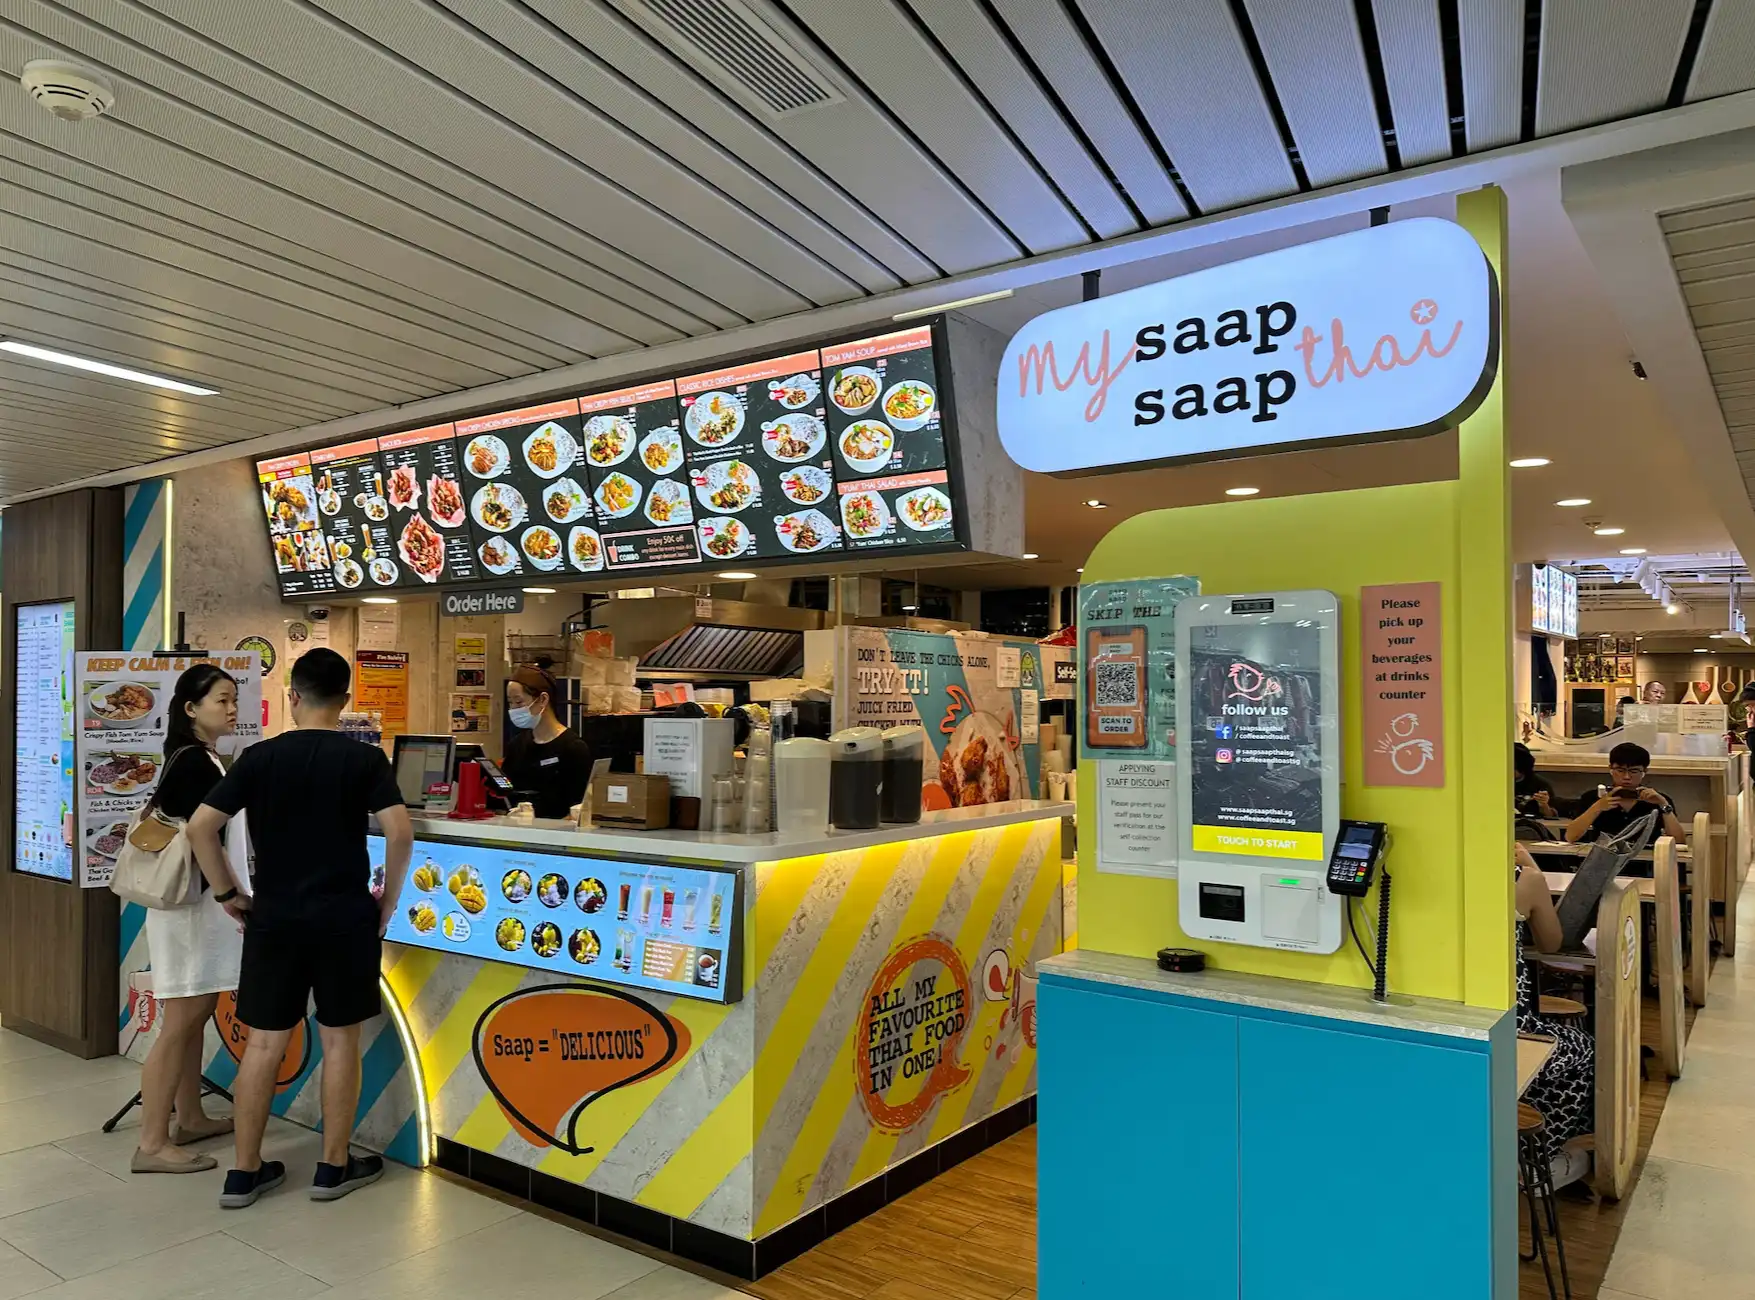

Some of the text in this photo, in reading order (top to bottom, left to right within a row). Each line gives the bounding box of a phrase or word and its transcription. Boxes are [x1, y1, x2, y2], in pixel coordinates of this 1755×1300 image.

[824, 354, 841, 363] TOM
[856, 346, 876, 357] SOUP
[1018, 298, 1464, 423] my saap thai
[1133, 369, 1297, 428] saap
[877, 478, 897, 488] SALAD
[646, 537, 663, 546] Enjoy
[675, 534, 684, 543] off
[619, 553, 640, 562] COMBO
[446, 592, 516, 613] Order Here
[1381, 599, 1421, 609] Please
[1087, 605, 1161, 620] SKIP THE
[1379, 617, 1423, 629] pick up
[1387, 636, 1415, 647] your
[86, 657, 126, 672] KEEP
[128, 657, 170, 672] CALM
[173, 656, 185, 671] &
[224, 655, 252, 670] ON!
[857, 648, 886, 662] DON'T
[890, 650, 916, 663] LEAVE
[919, 652, 934, 665] THE
[938, 653, 964, 667] CHICKS
[1372, 653, 1432, 664] beverages
[857, 667, 929, 695] TRY IT!
[1375, 671, 1430, 681] at drinks
[1379, 690, 1426, 700] counter
[857, 701, 914, 714] JUICY FRIED
[1221, 703, 1289, 716] follow us
[148, 730, 165, 738] Soup
[1119, 764, 1156, 774] APPLYING
[1106, 778, 1171, 788] STAFF DISCOUNT
[1220, 806, 1293, 817] www.saapsaapthai.sg
[1217, 814, 1296, 825] www.coffeeandtoast.sg
[1216, 835, 1298, 849] TOUCH TO START
[869, 975, 937, 1018] ALL MY
[868, 988, 965, 1044] FAVOURITE
[493, 1034, 534, 1062] Saap
[552, 1023, 651, 1061] "DELICIOUS"
[868, 1012, 965, 1069] THAI FOOD
[869, 1043, 942, 1095] IN ONE!
